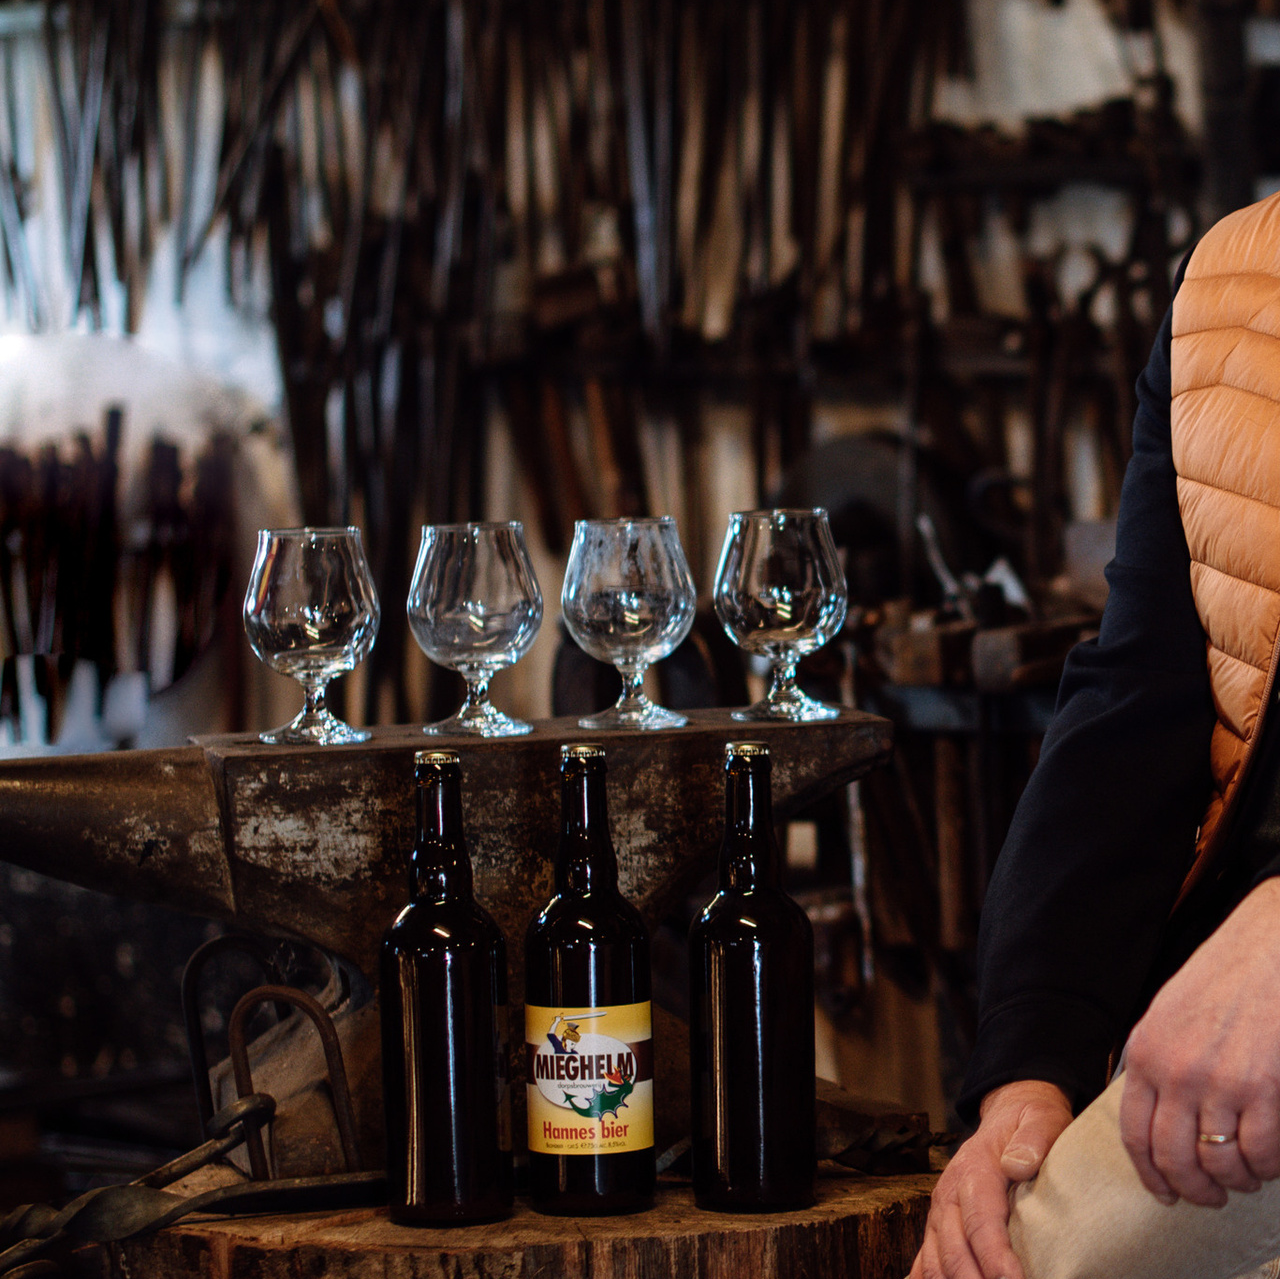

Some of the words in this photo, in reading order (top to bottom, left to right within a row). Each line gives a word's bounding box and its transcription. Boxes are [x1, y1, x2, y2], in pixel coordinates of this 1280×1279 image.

[536, 1052, 634, 1080] MIEGHELM
[543, 1120, 596, 1140] Hannes
[601, 1120, 629, 1139] bier
